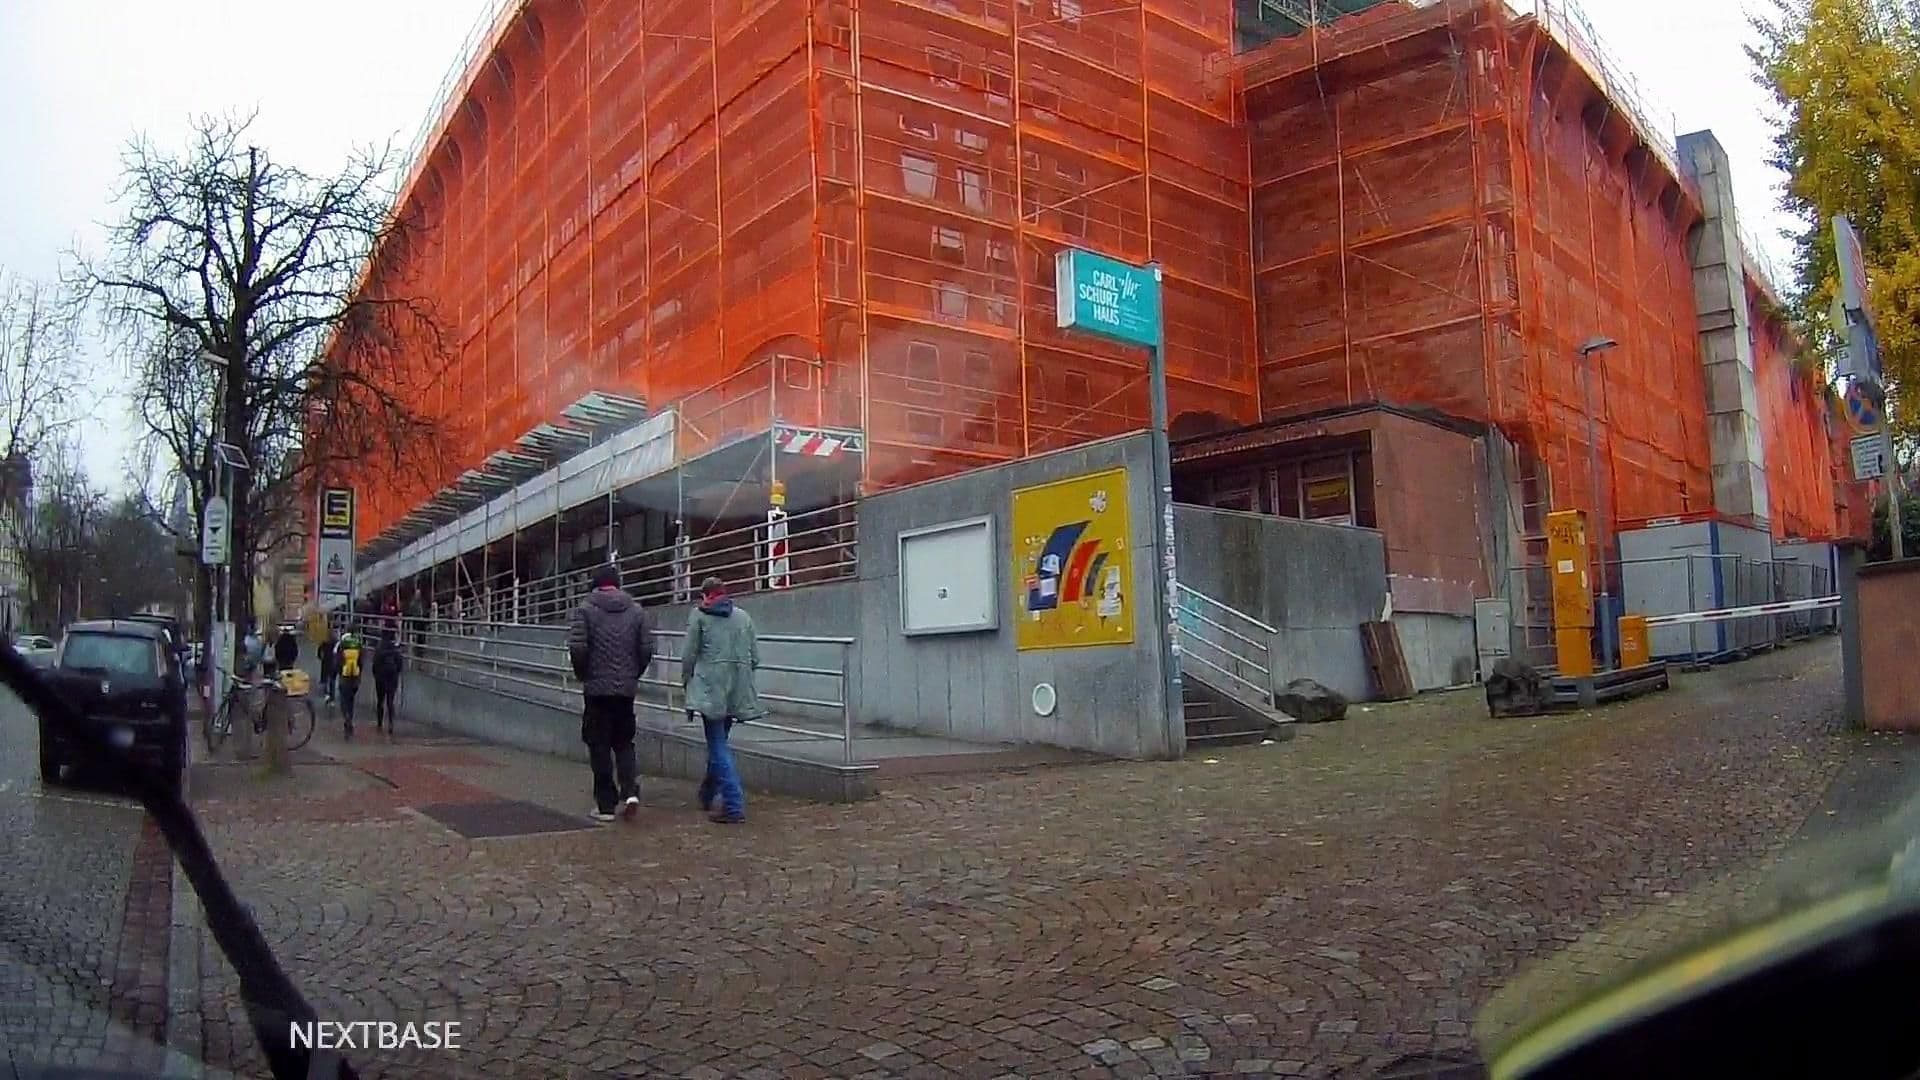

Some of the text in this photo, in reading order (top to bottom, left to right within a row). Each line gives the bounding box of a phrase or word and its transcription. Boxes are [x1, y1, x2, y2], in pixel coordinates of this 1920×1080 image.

[1092, 270, 1119, 291] CARL
[1079, 283, 1119, 308] SCHURZ
[1093, 303, 1119, 325] HAUS
